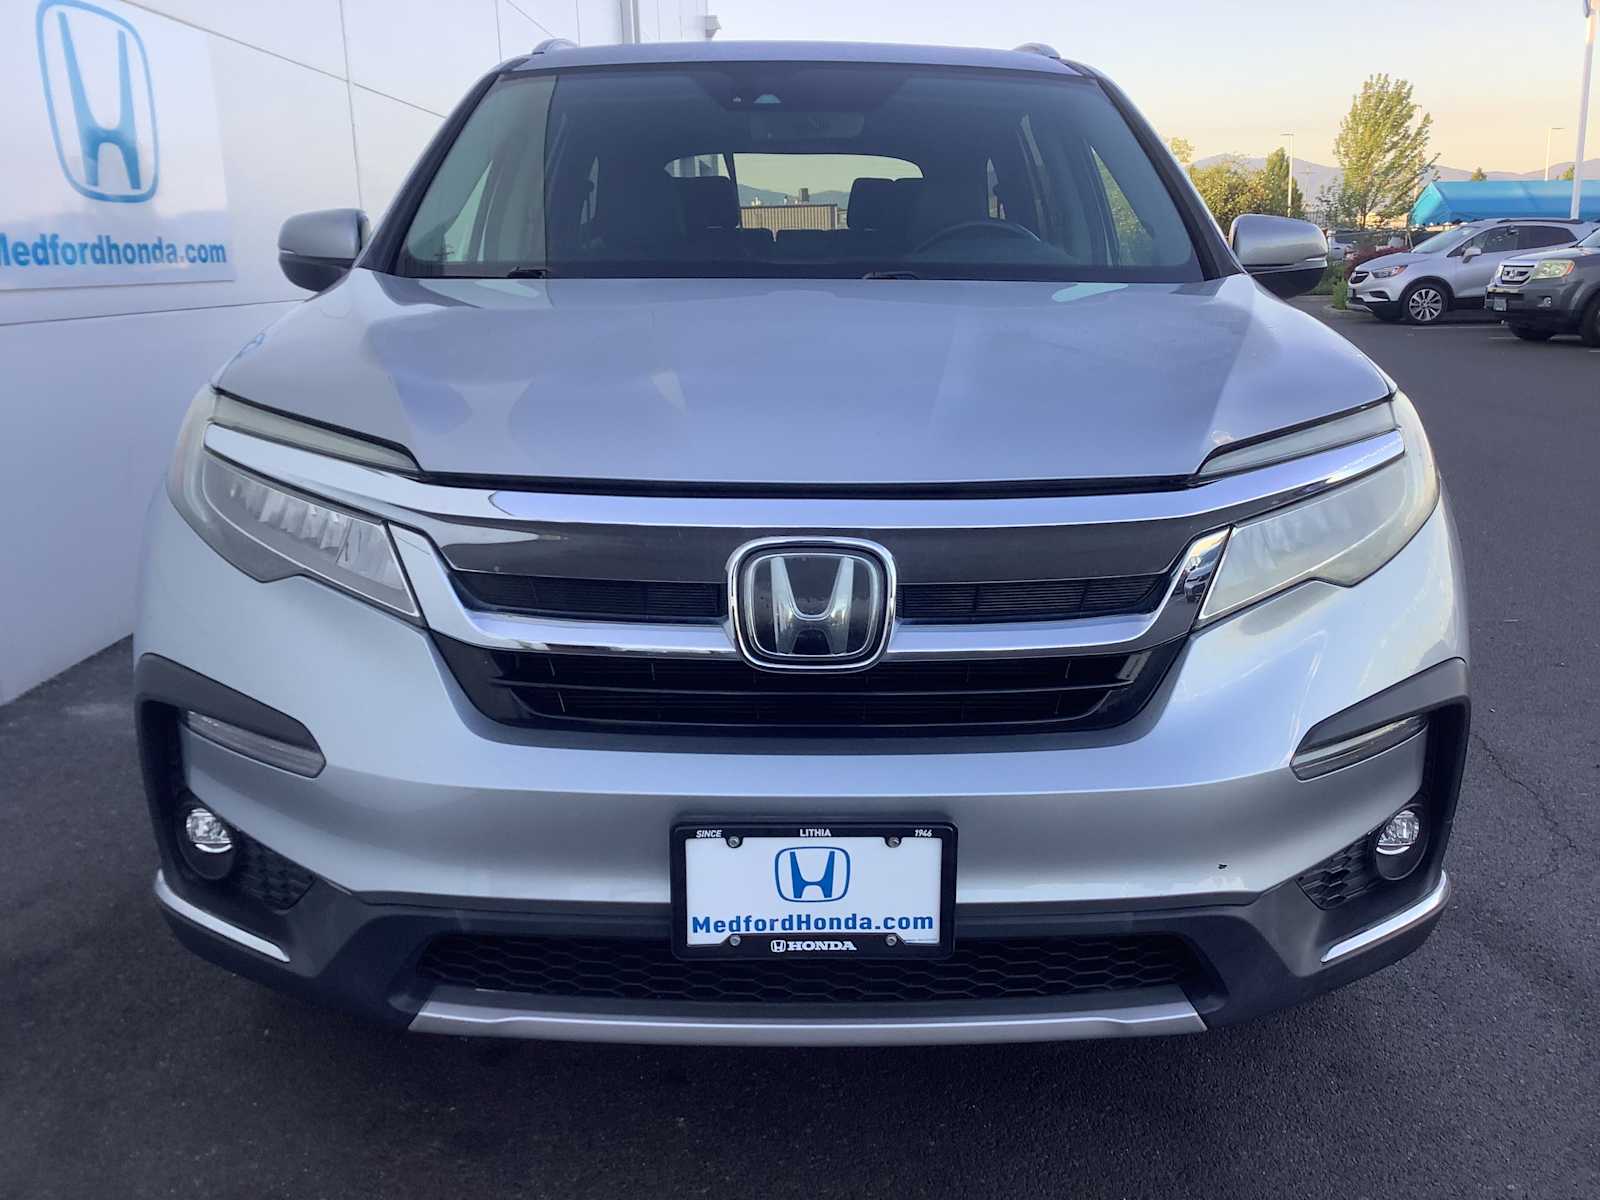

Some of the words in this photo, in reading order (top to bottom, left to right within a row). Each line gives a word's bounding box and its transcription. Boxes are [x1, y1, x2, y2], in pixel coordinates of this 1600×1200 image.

[696, 830, 722, 838] SINCE
[800, 829, 831, 837] LITHIA
[915, 829, 932, 837] 1946
[692, 913, 933, 933] MedfordHonda.com
[787, 941, 857, 951] HONDA
